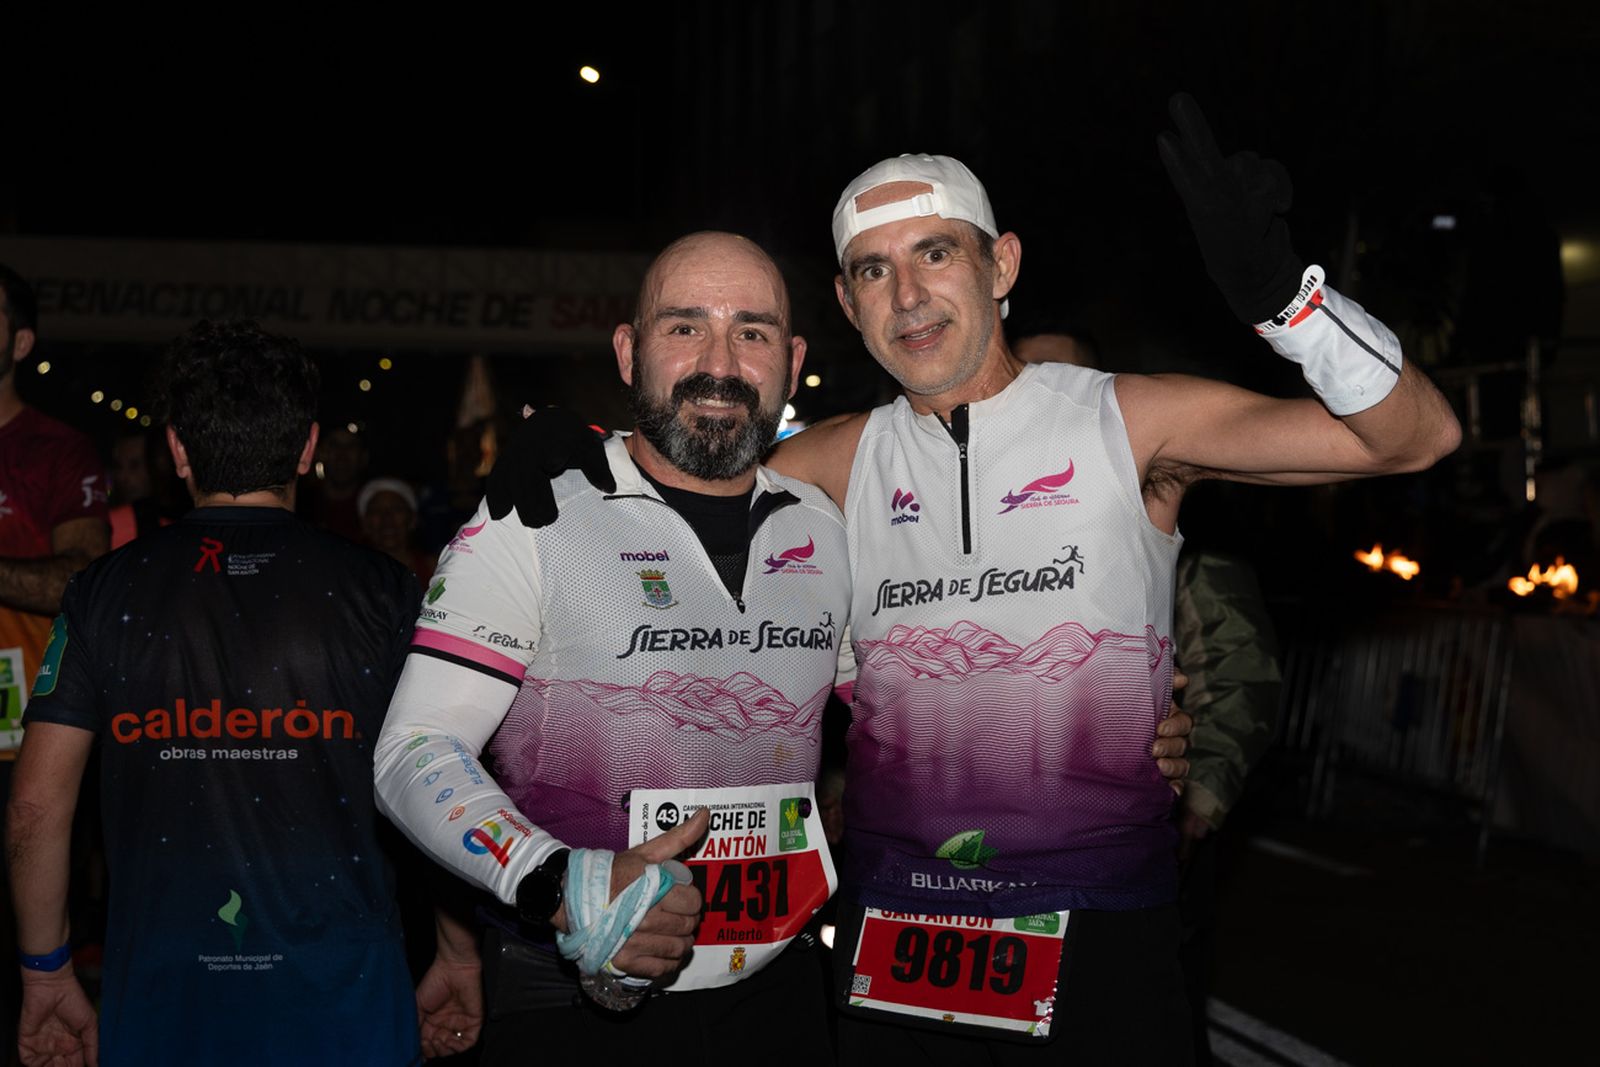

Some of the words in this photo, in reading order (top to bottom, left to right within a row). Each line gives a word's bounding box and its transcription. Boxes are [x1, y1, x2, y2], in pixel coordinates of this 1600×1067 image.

[326, 289, 471, 328] NOCHE
[481, 293, 535, 329] DE
[891, 513, 919, 526] mobel
[620, 550, 670, 562] mobel
[872, 578, 944, 616] SIERRA
[948, 578, 972, 596] DE
[970, 566, 1075, 602] SEGURA
[616, 624, 723, 659] SIERRA
[728, 630, 750, 645] DE
[750, 620, 833, 653] SEGURA
[160, 747, 207, 760] obras
[212, 747, 299, 760] maestras
[657, 809, 678, 823] 43
[747, 810, 767, 829] DE
[703, 830, 767, 858] ANTÓN
[717, 927, 763, 941] Alberto
[890, 926, 1028, 996] 9819
